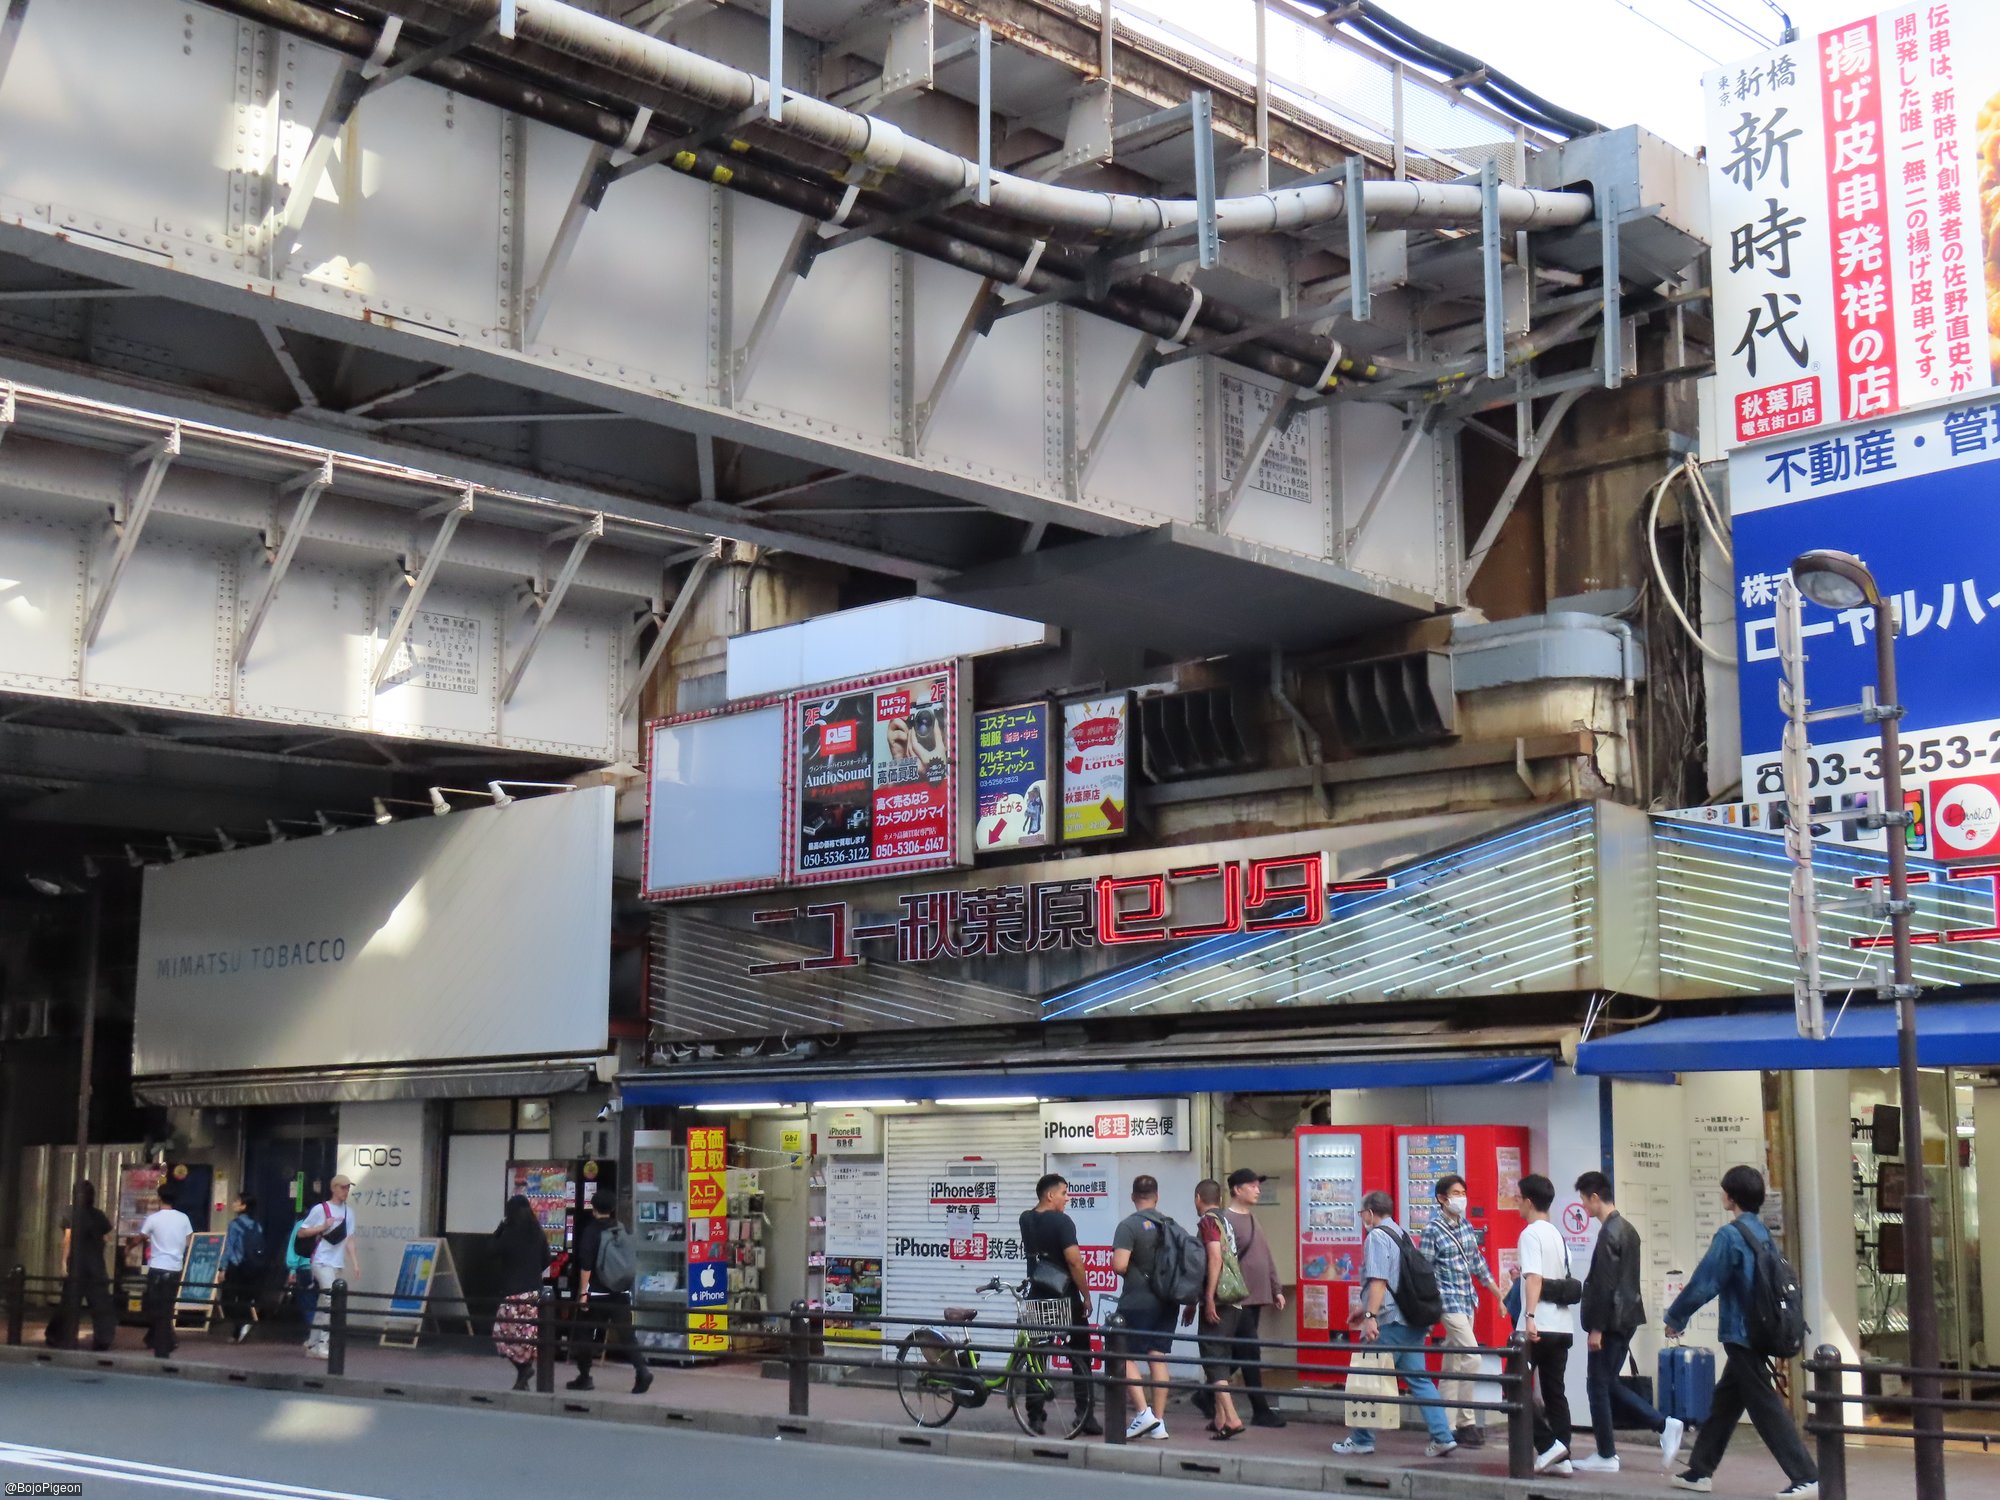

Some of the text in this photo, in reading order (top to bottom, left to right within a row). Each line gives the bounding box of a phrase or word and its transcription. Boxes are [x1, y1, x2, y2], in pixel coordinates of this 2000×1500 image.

[1735, 54, 1797, 101] 新橋
[1893, 12, 1939, 388] 開発した唯一無二の揚げ皮串です。
[1824, 24, 1891, 418] 揚げ皮串発祥の店
[1721, 107, 1809, 379] 新時代
[1741, 380, 1813, 417] 秋葉原
[1741, 406, 1816, 437] 電気街口店
[1765, 405, 2000, 493] 不動産・管
[1745, 578, 2000, 663] ローヤルハ
[931, 682, 946, 703] 2F
[804, 707, 820, 728] 2F
[979, 709, 1037, 731] コスチューム
[980, 731, 1001, 747] 制服
[979, 746, 1030, 764] ワルキューレ
[1085, 757, 1125, 771] LOTUS
[804, 764, 872, 788] AudioSound
[877, 766, 919, 785] 高価買取
[876, 791, 929, 811] 高く売るなら
[1065, 789, 1100, 804] 秋葉原店
[876, 804, 944, 827] カメラのリサマイ
[803, 846, 870, 867] 050-5536-3122
[876, 837, 944, 858] 050-5306-6147
[749, 851, 1395, 975] ニュー秋葉原センター
[157, 938, 345, 979] MIMATSU TOBACCO
[1044, 1116, 1174, 1138] iPhone修理救急便
[690, 1130, 724, 1150] 高価
[354, 1148, 402, 1170] IQOS
[690, 1150, 725, 1170] 買取
[691, 1184, 717, 1198] 入口
[931, 1182, 997, 1198] iPhone修理
[1068, 1181, 1106, 1193] hone修理
[1070, 1197, 1095, 1208] 救急便
[1086, 1271, 1117, 1289] 20分
[699, 1291, 725, 1301] iPhone
